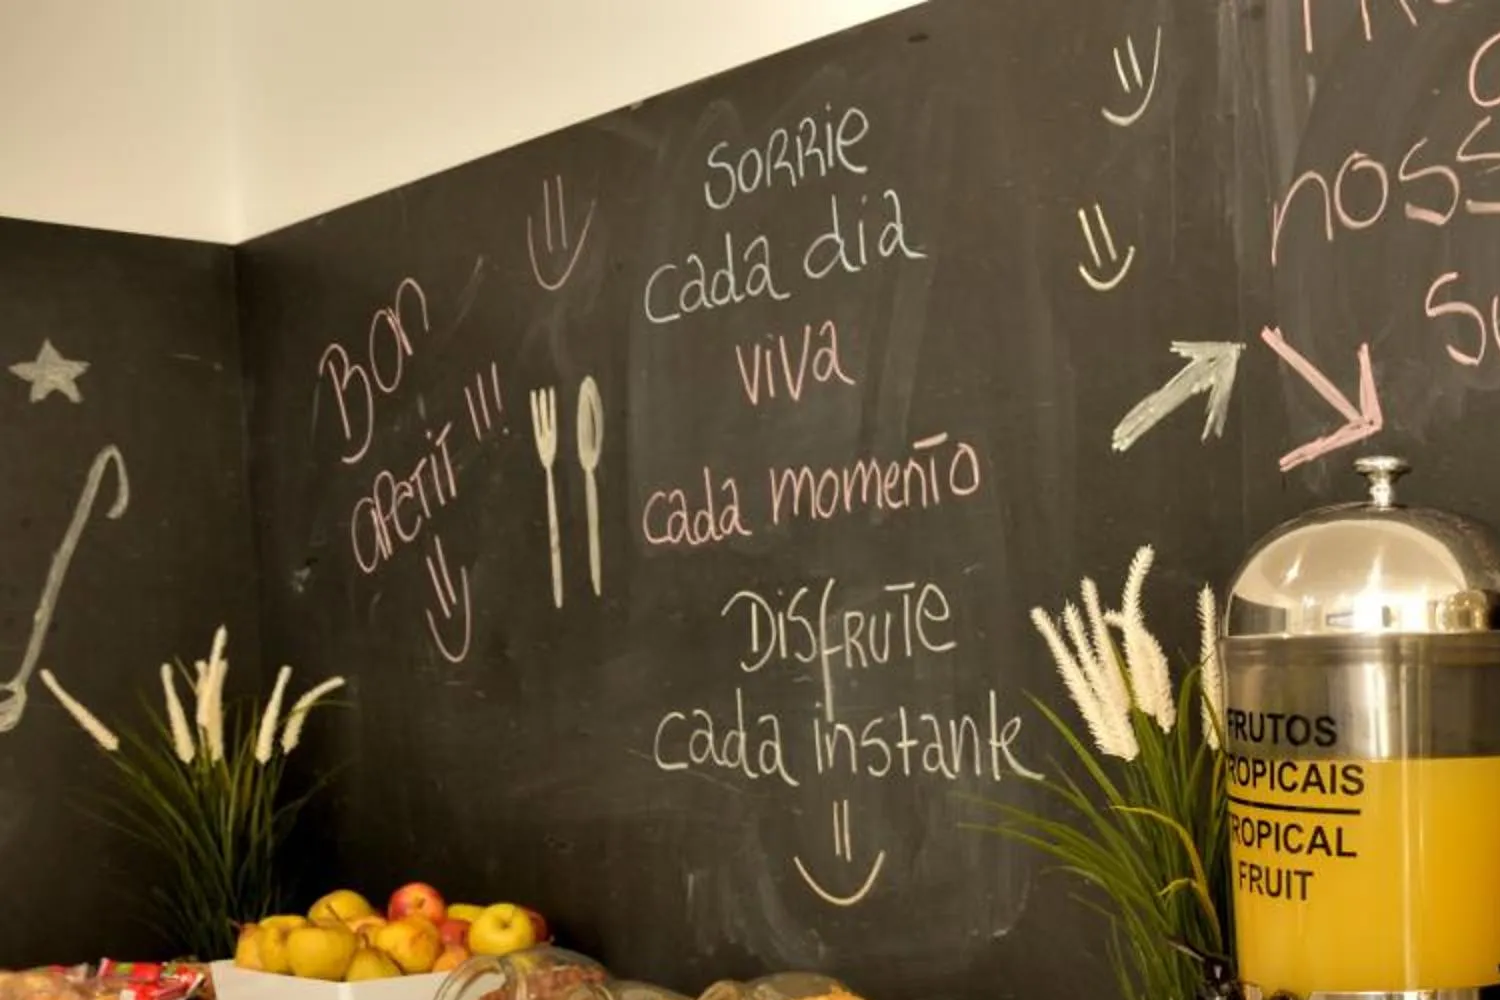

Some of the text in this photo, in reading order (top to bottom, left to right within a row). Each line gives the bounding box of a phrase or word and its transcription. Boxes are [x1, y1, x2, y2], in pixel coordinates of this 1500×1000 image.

[803, 189, 928, 279] dia
[813, 690, 1045, 782] instante
[1227, 707, 1338, 747] FRUTOS
[1228, 752, 1365, 797] ROPICAIS
[1229, 812, 1358, 858] ROPICAL
[1238, 860, 1314, 901] FRUIT
